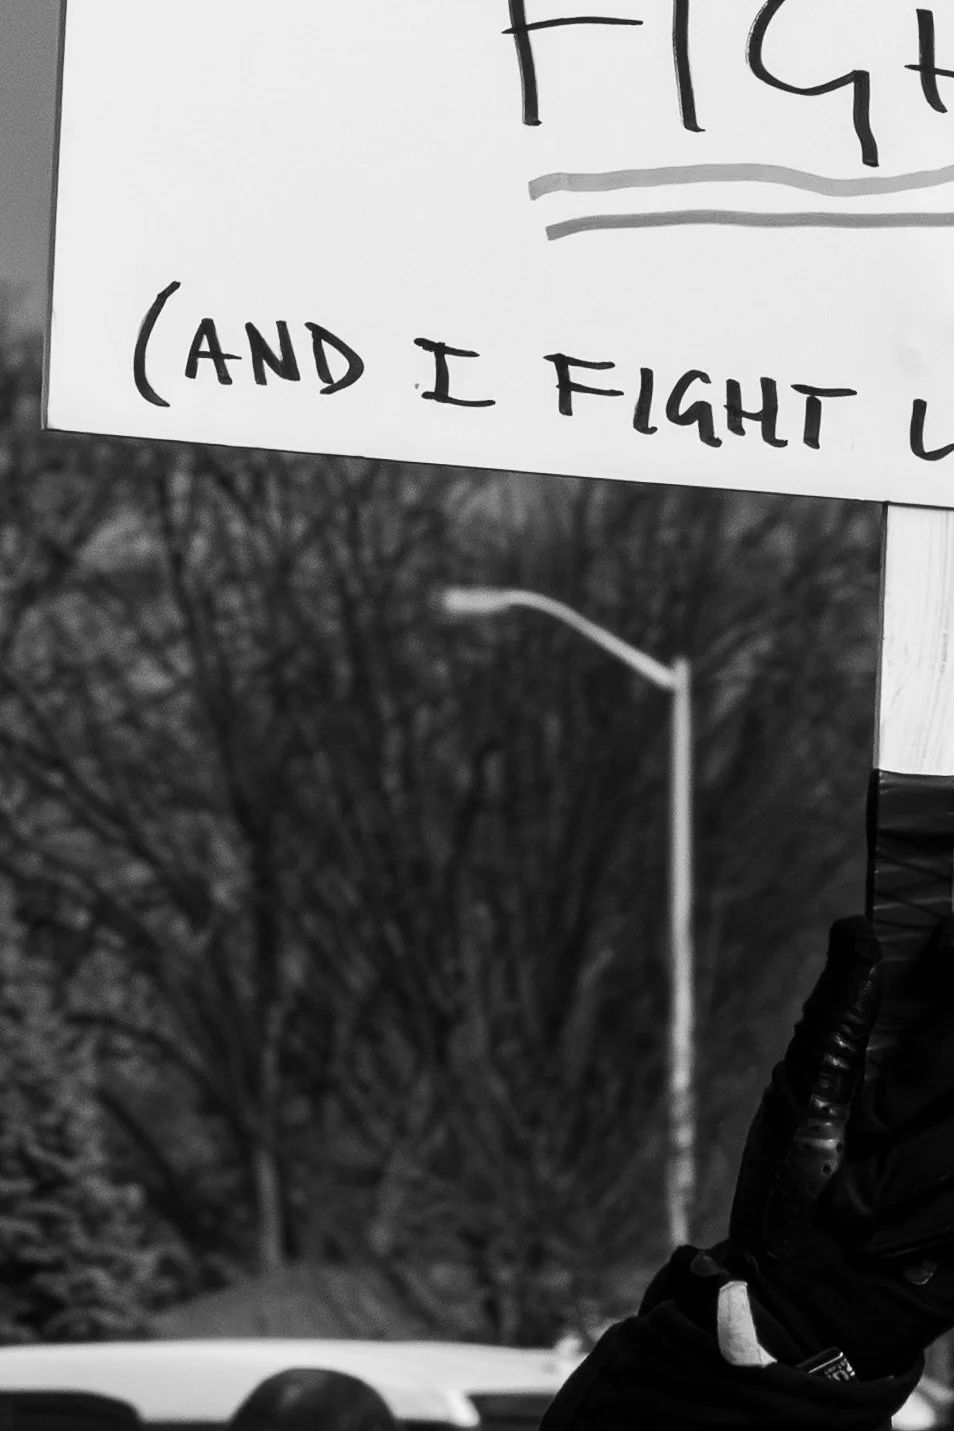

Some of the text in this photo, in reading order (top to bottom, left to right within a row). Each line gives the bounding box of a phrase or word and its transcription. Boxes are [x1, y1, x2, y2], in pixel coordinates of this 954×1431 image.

[132, 280, 365, 409] (AND
[412, 337, 497, 409] I
[542, 352, 858, 451] FIGHT
